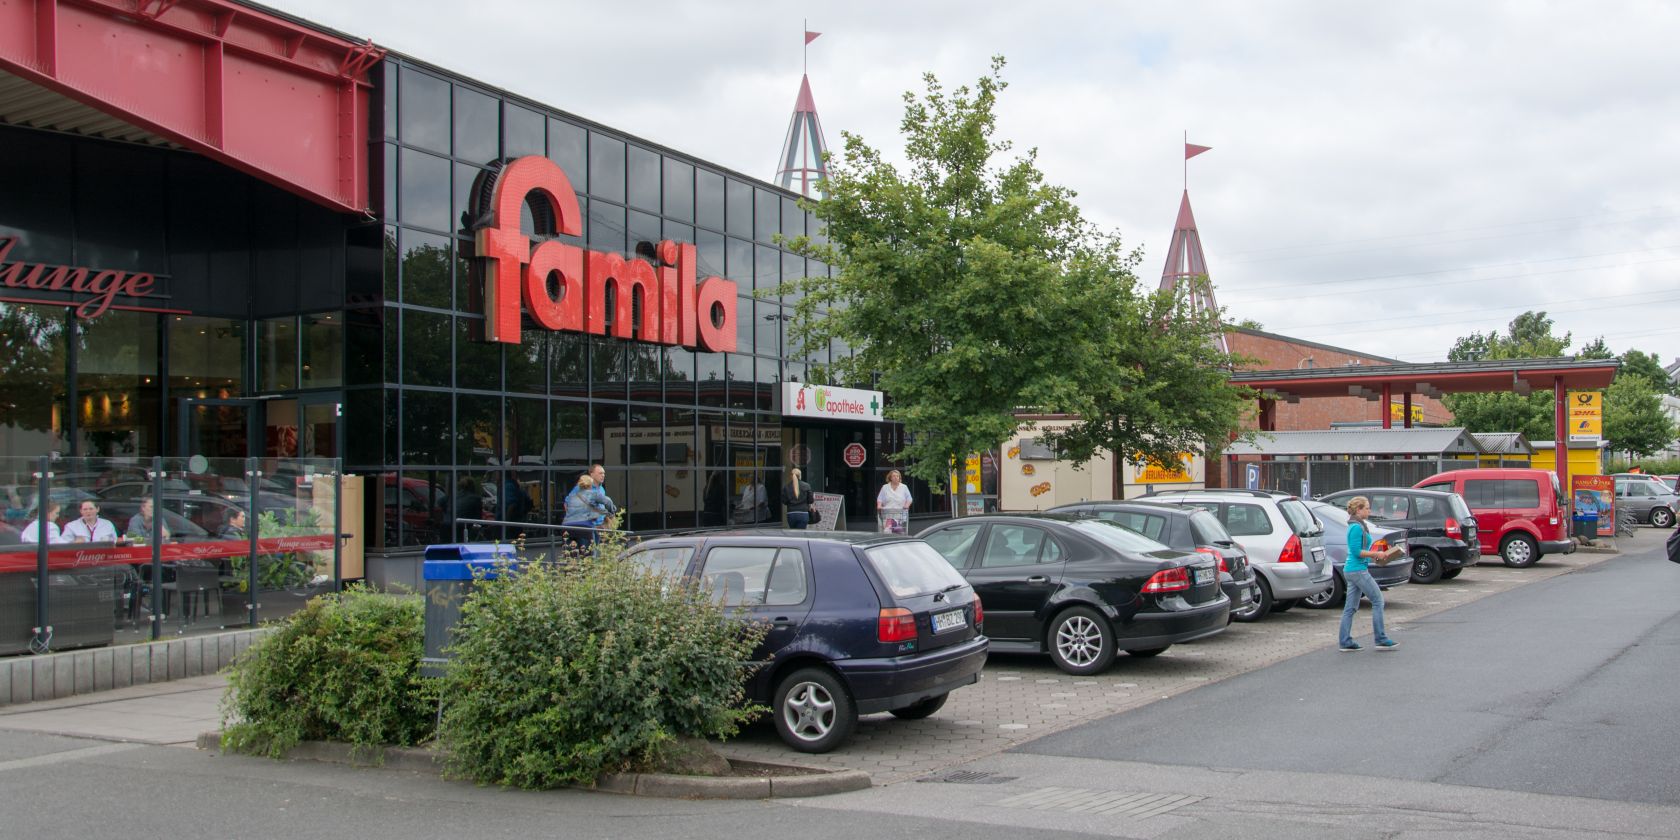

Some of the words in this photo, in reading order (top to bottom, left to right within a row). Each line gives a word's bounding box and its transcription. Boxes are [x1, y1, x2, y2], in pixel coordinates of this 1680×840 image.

[476, 155, 737, 353] famila
[826, 399, 865, 415] apotheke
[1249, 469, 1256, 490] P
[1303, 484, 1308, 496] P
